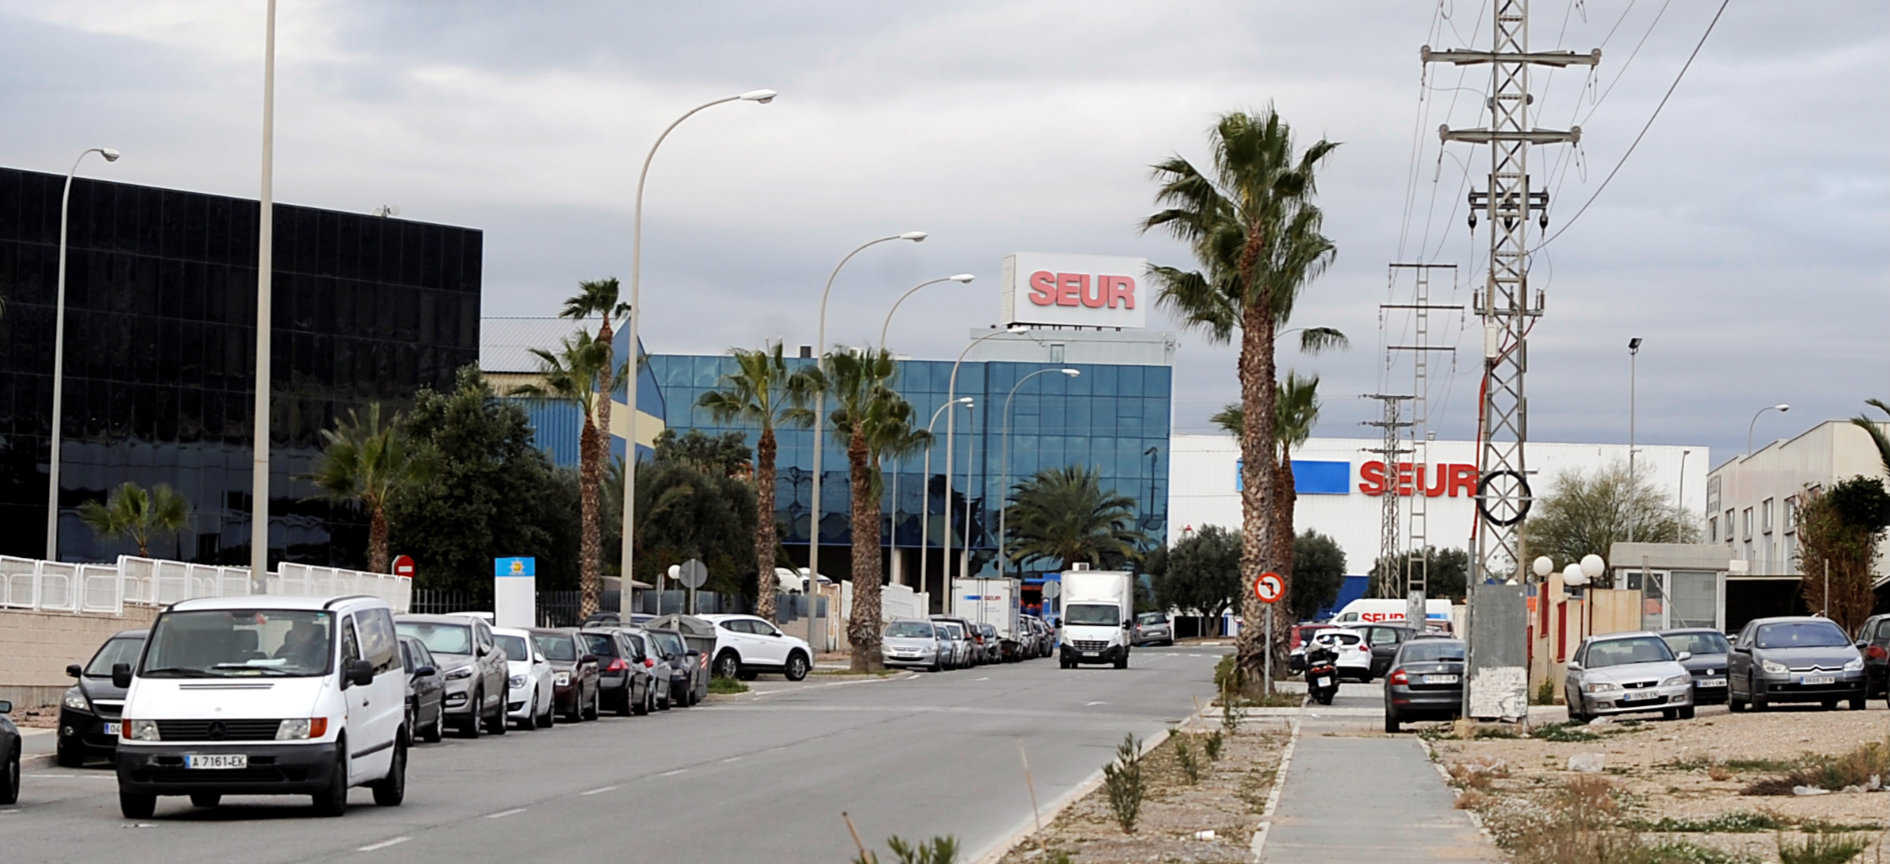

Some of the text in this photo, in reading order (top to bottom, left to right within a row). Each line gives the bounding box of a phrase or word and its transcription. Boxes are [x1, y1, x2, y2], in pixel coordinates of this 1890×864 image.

[1028, 270, 1135, 310] SEUR
[1358, 460, 1479, 498] SEUR
[193, 757, 199, 767] A
